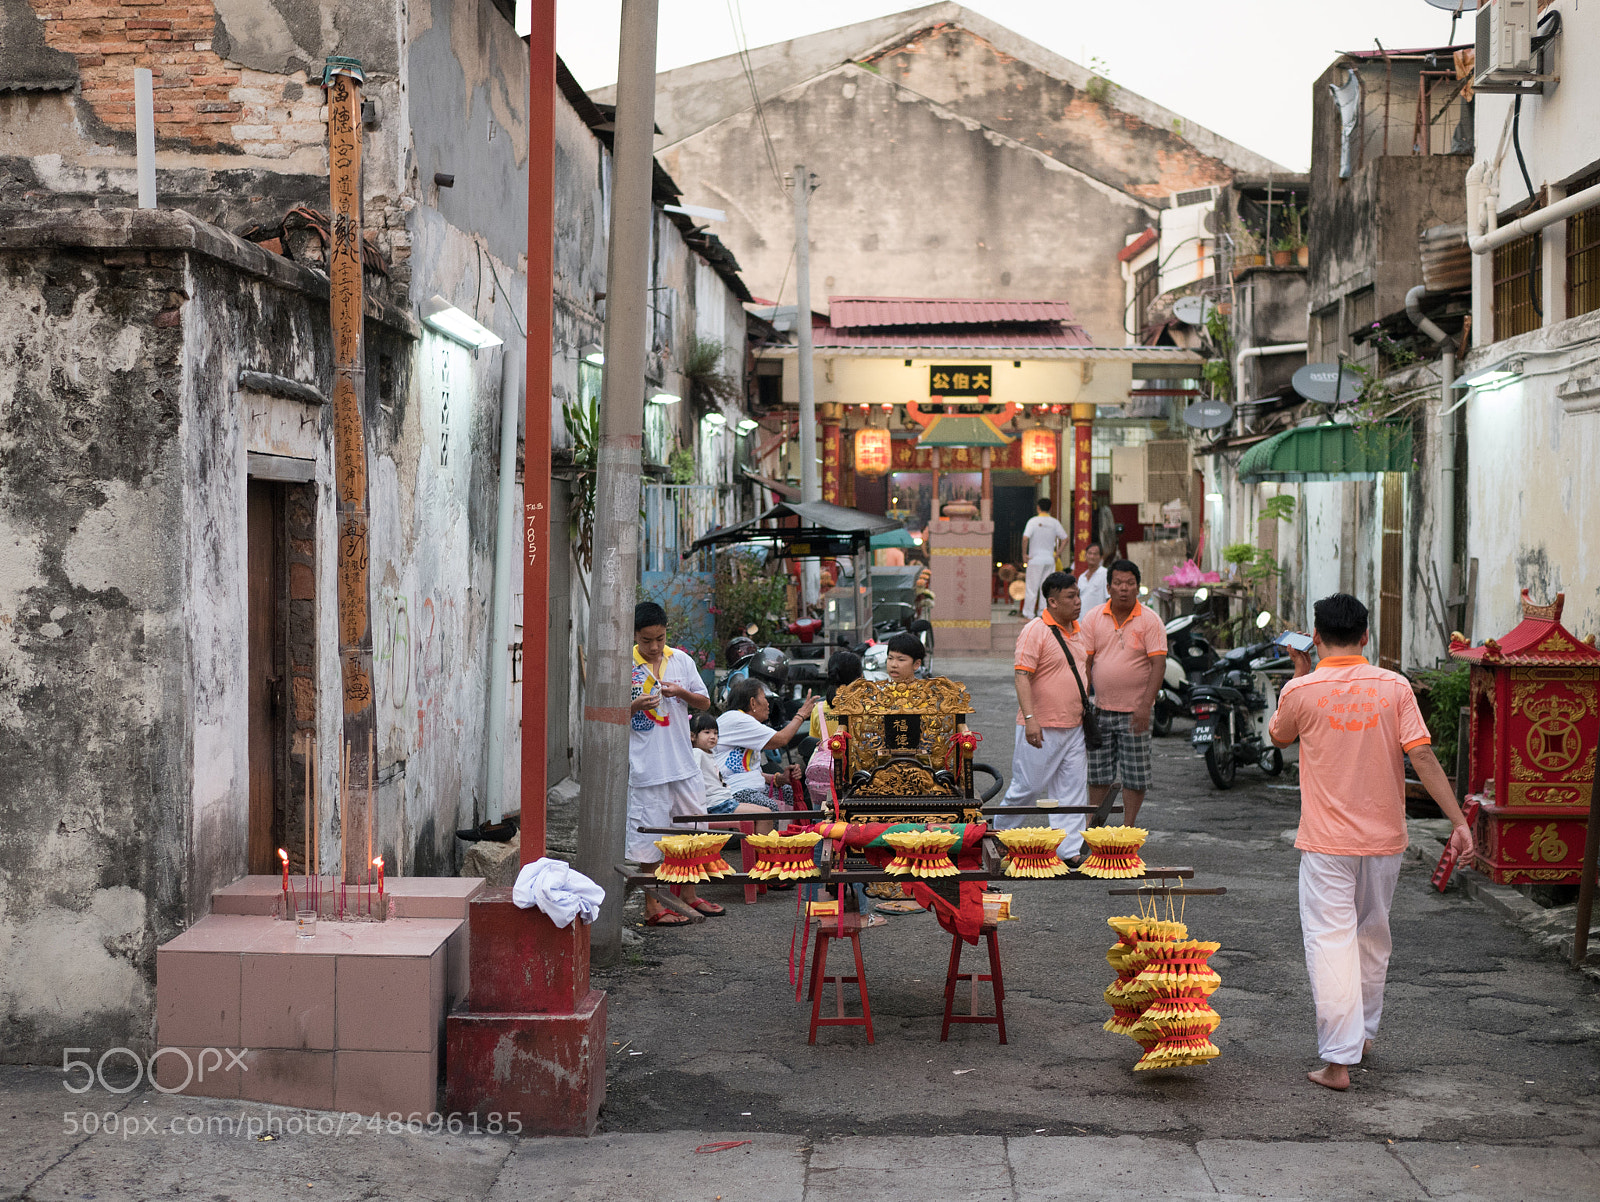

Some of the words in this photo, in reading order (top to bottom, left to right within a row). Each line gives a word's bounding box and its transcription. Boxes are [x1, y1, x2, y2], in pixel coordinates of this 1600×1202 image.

[1310, 372, 1339, 382] astro
[527, 516, 536, 566] 7857
[893, 719, 910, 750] 福德
[1526, 822, 1569, 863] 福
